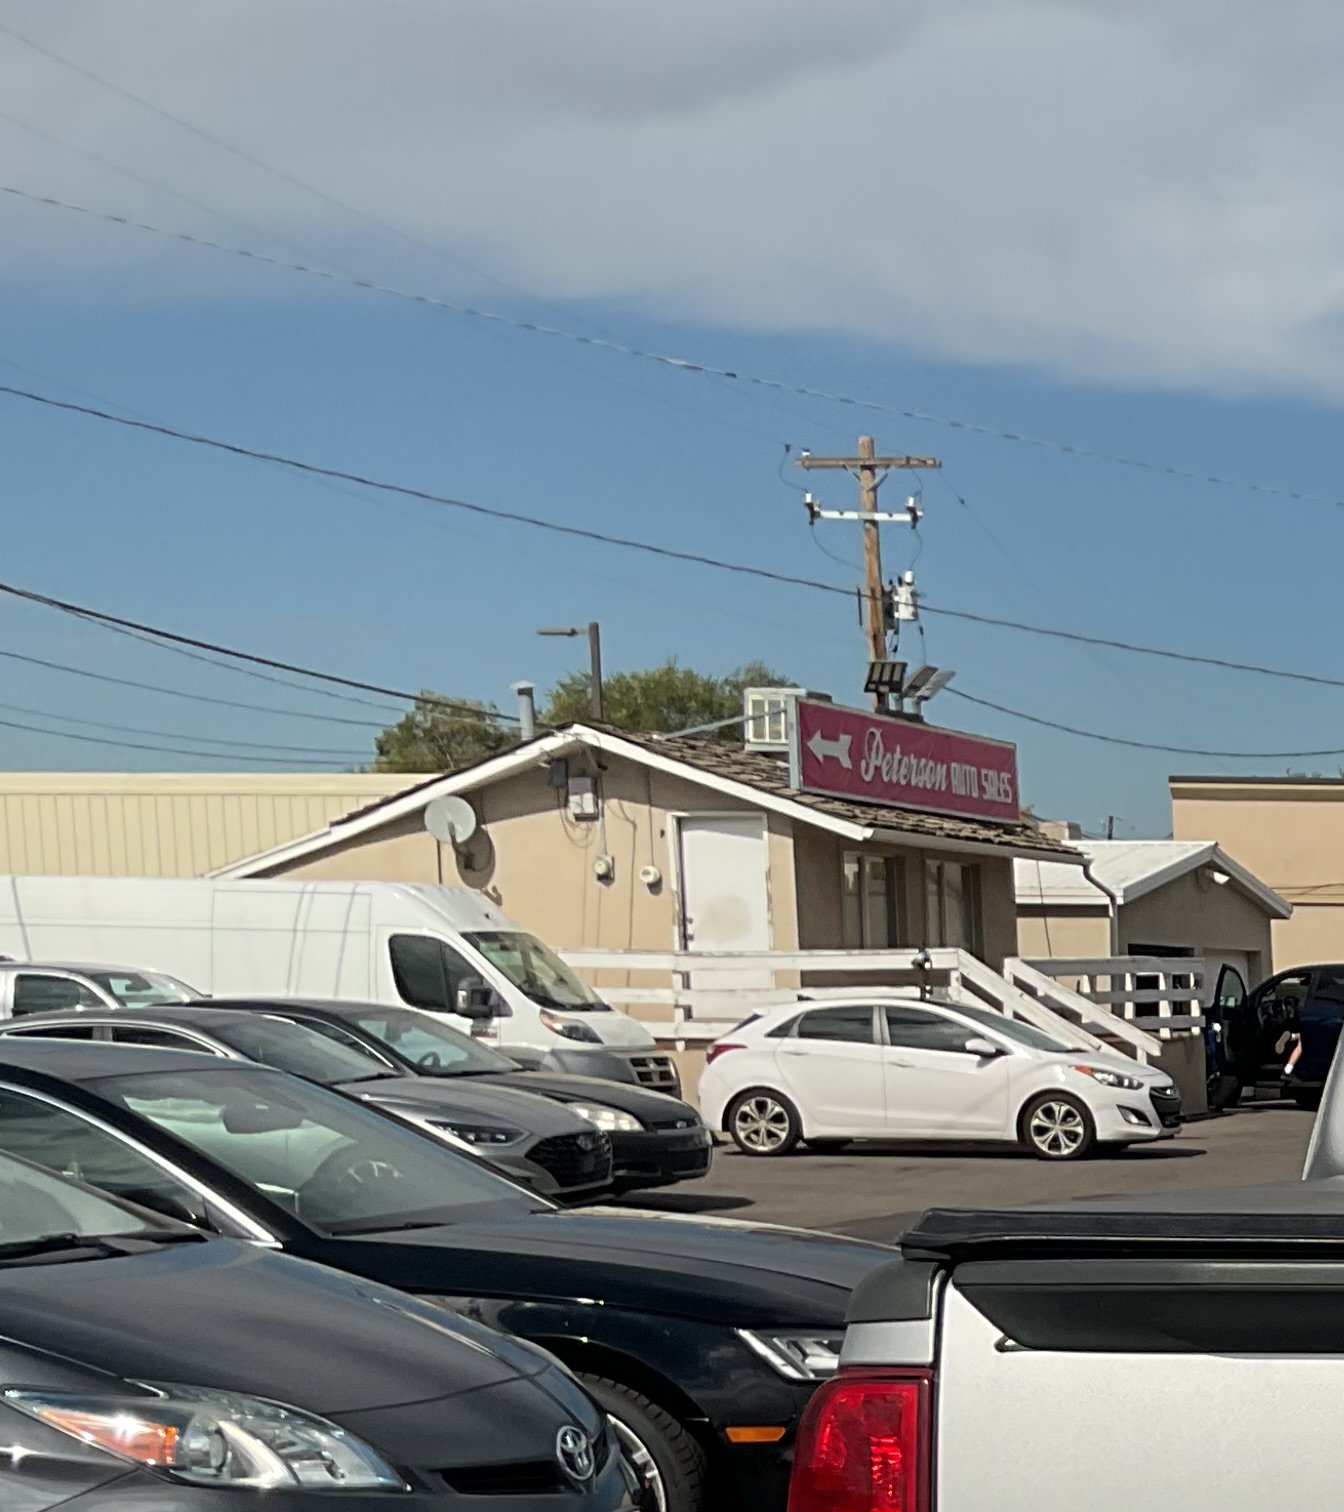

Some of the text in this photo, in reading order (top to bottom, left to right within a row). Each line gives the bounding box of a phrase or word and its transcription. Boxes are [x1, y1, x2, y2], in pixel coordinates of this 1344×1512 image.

[860, 726, 1013, 803] Peterson AUTO SALES
